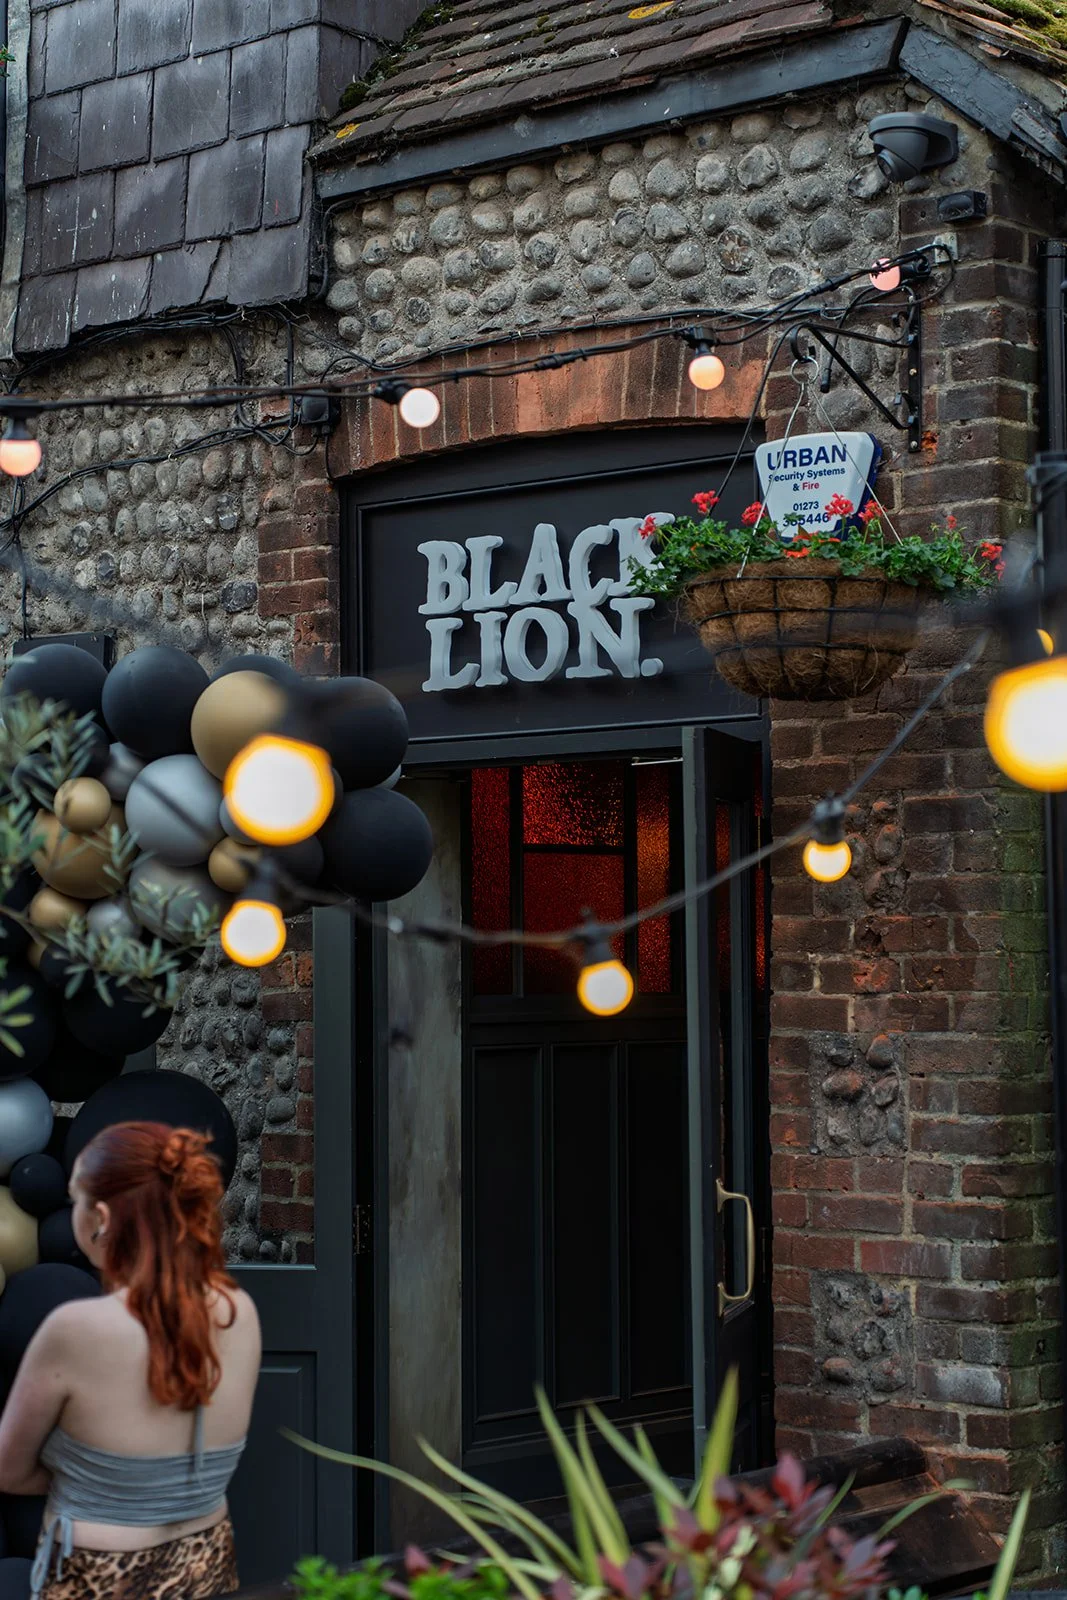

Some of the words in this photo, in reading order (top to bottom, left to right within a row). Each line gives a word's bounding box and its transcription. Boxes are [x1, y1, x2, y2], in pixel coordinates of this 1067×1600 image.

[767, 444, 847, 471] URBAN
[768, 471, 805, 483] Security
[807, 467, 846, 480] Systems
[792, 483, 800, 492] &
[802, 481, 820, 491] Fire
[793, 501, 820, 512] 01273
[417, 512, 675, 615] BLACK
